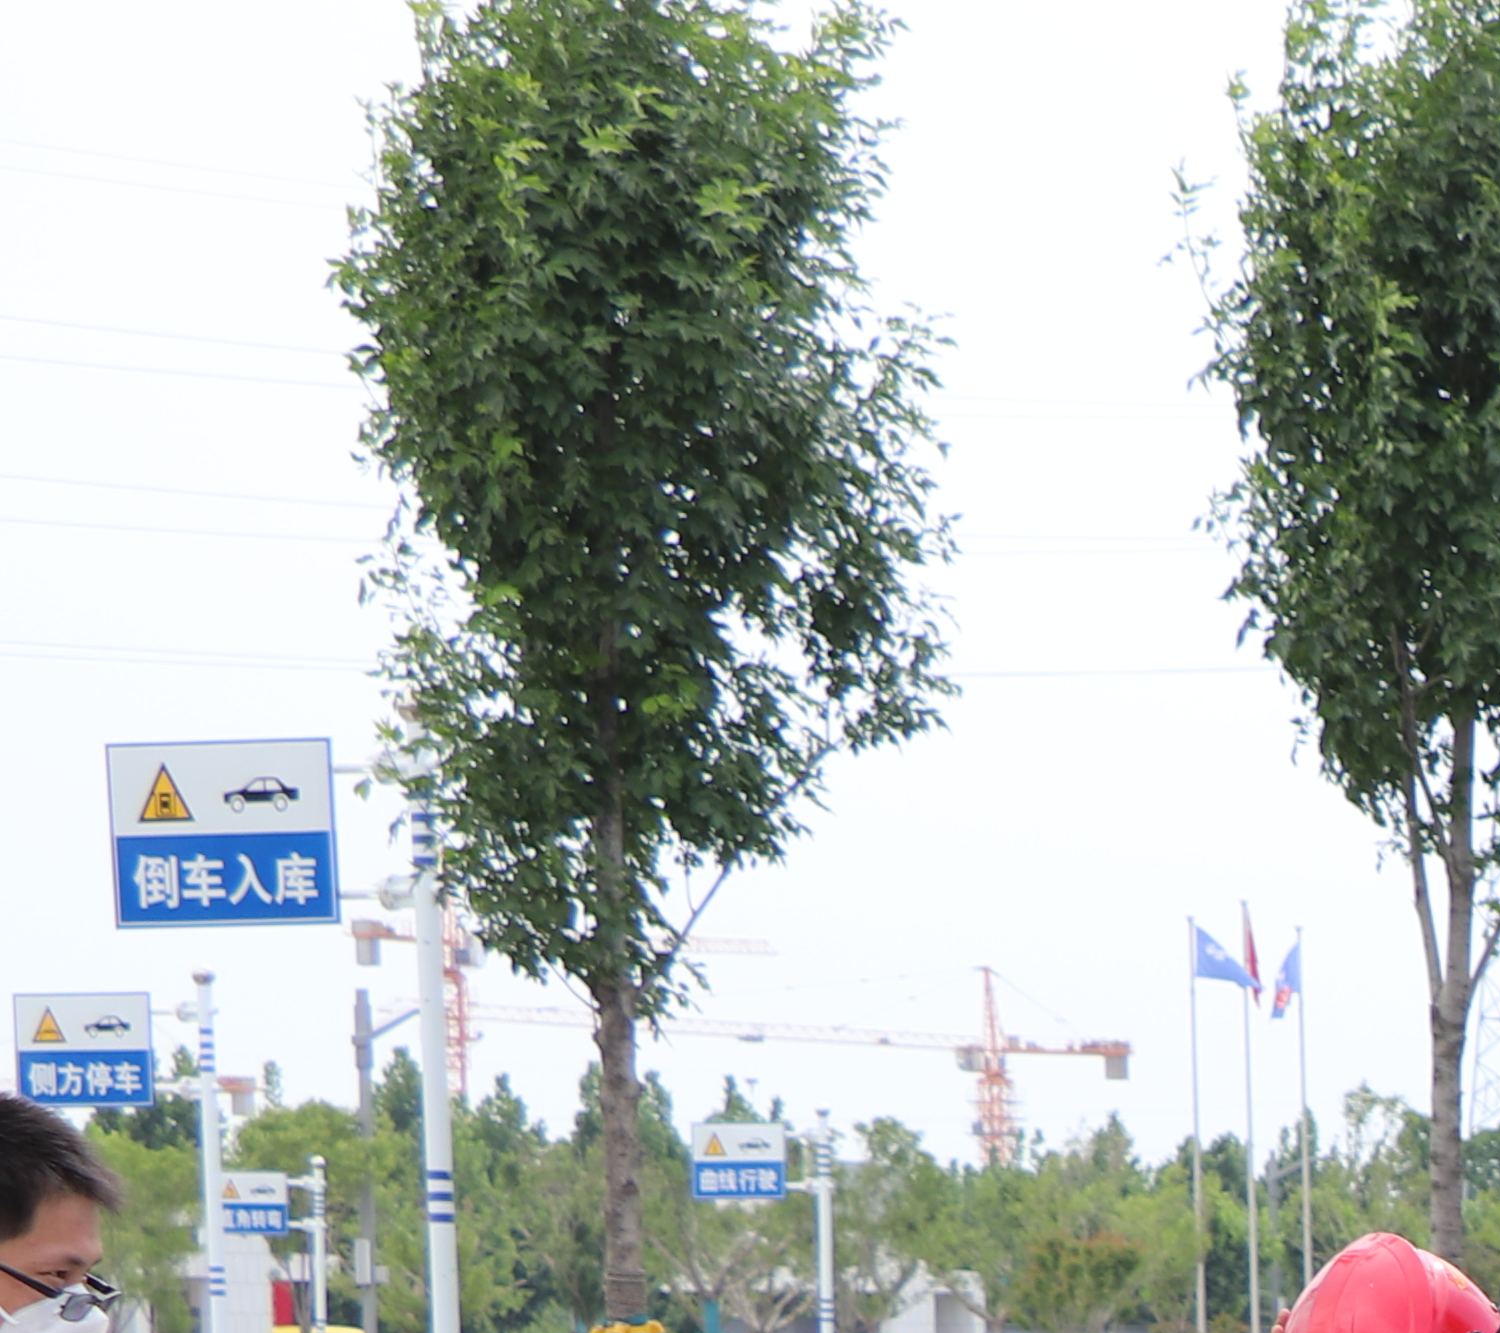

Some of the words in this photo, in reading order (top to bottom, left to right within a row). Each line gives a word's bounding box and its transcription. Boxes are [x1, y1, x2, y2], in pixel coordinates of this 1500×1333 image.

[133, 853, 319, 908] 倒车入库
[29, 1063, 142, 1096] 侧方停车
[699, 1168, 778, 1193] 曲线行驶
